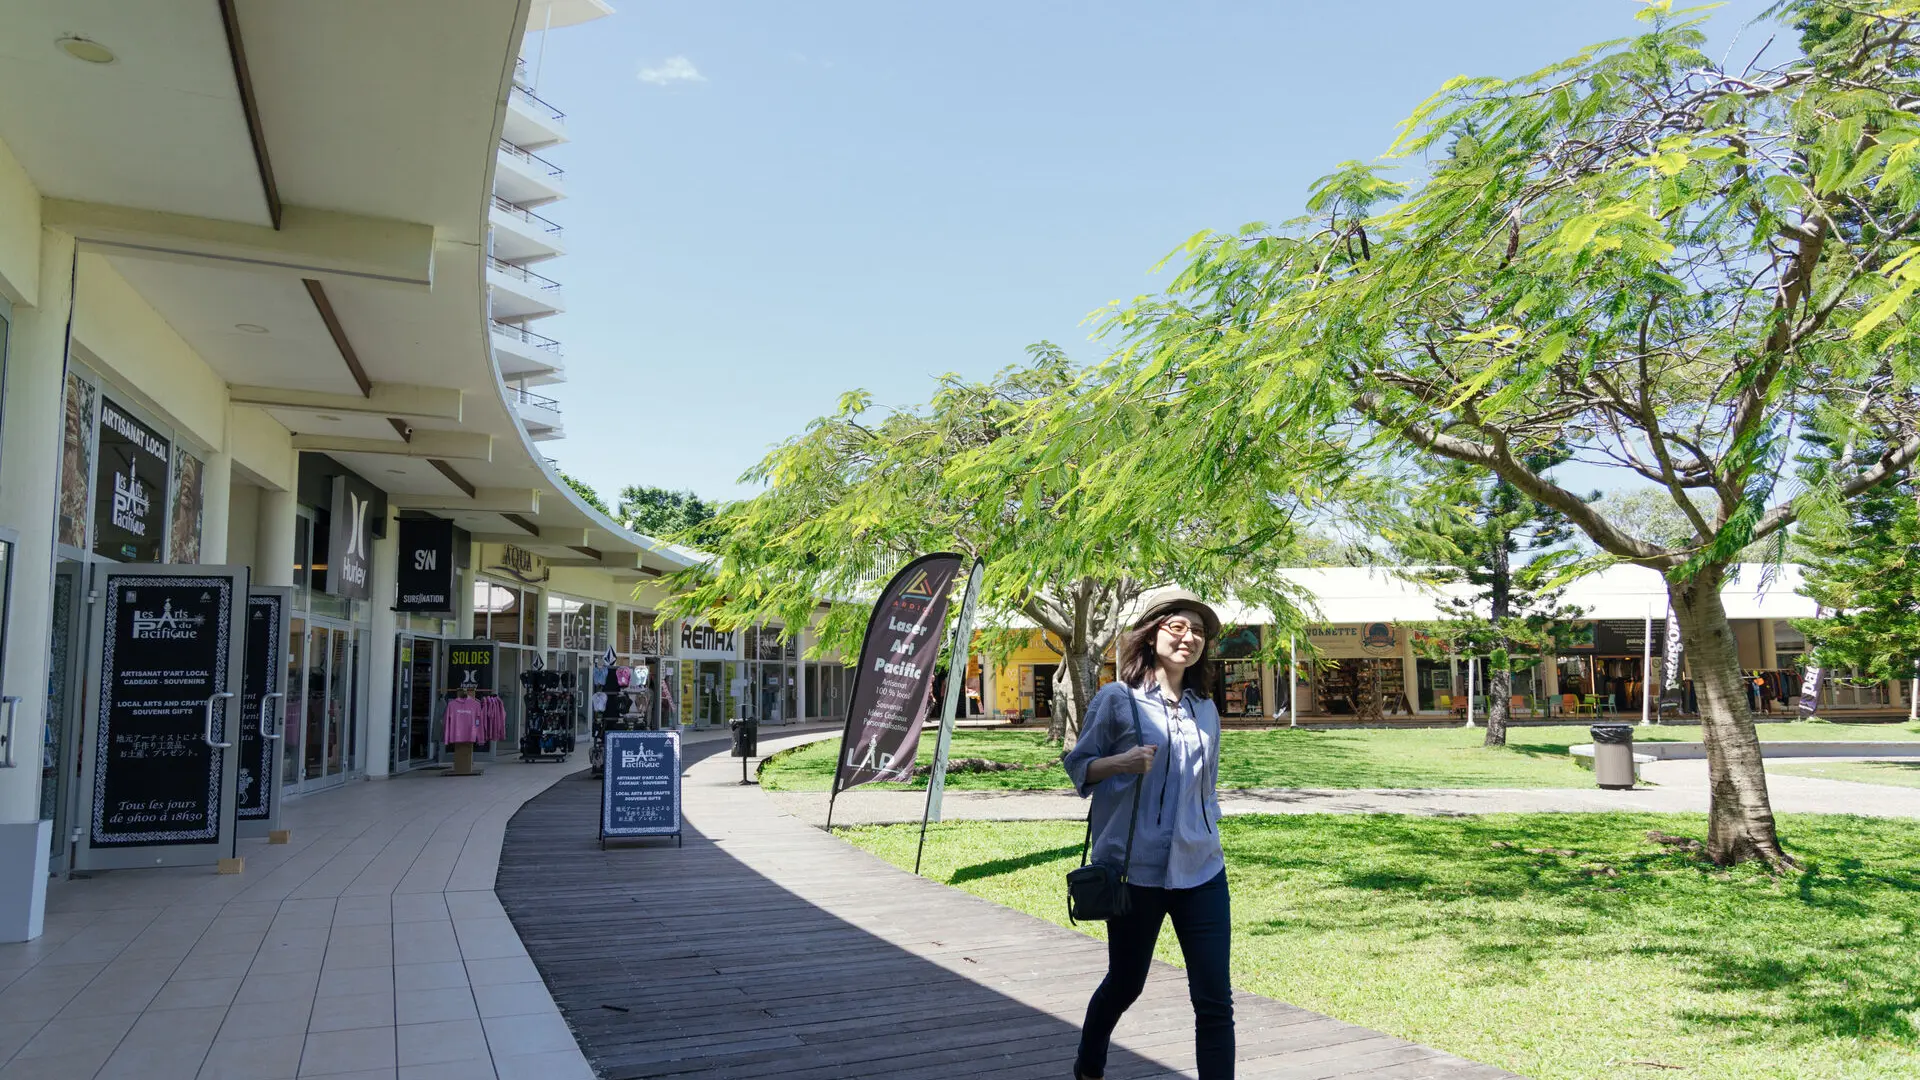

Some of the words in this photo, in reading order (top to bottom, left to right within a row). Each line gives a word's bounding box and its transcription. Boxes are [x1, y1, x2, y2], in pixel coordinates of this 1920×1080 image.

[101, 406, 146, 448] ARTISANAT
[145, 434, 167, 463] LOCAL
[115, 471, 127, 495] Les
[503, 545, 532, 574] AQUA
[343, 556, 366, 588] Hurley
[133, 610, 154, 621] Les
[888, 616, 928, 636] Laser
[681, 624, 734, 651] REMAX
[889, 639, 915, 655] Art
[452, 651, 490, 665] SOLDES
[874, 658, 921, 680] Pacific
[876, 687, 887, 695] 100
[882, 679, 907, 689] Artisanat
[876, 701, 903, 712] Souvenirs
[868, 709, 882, 718] Idées
[884, 712, 908, 722] Cadeaux
[863, 718, 908, 732] Personnalisation
[118, 800, 145, 811] Tous
[148, 799, 164, 810] les
[166, 799, 197, 810] jours
[109, 813, 124, 823] de
[171, 811, 203, 822] 18h30
